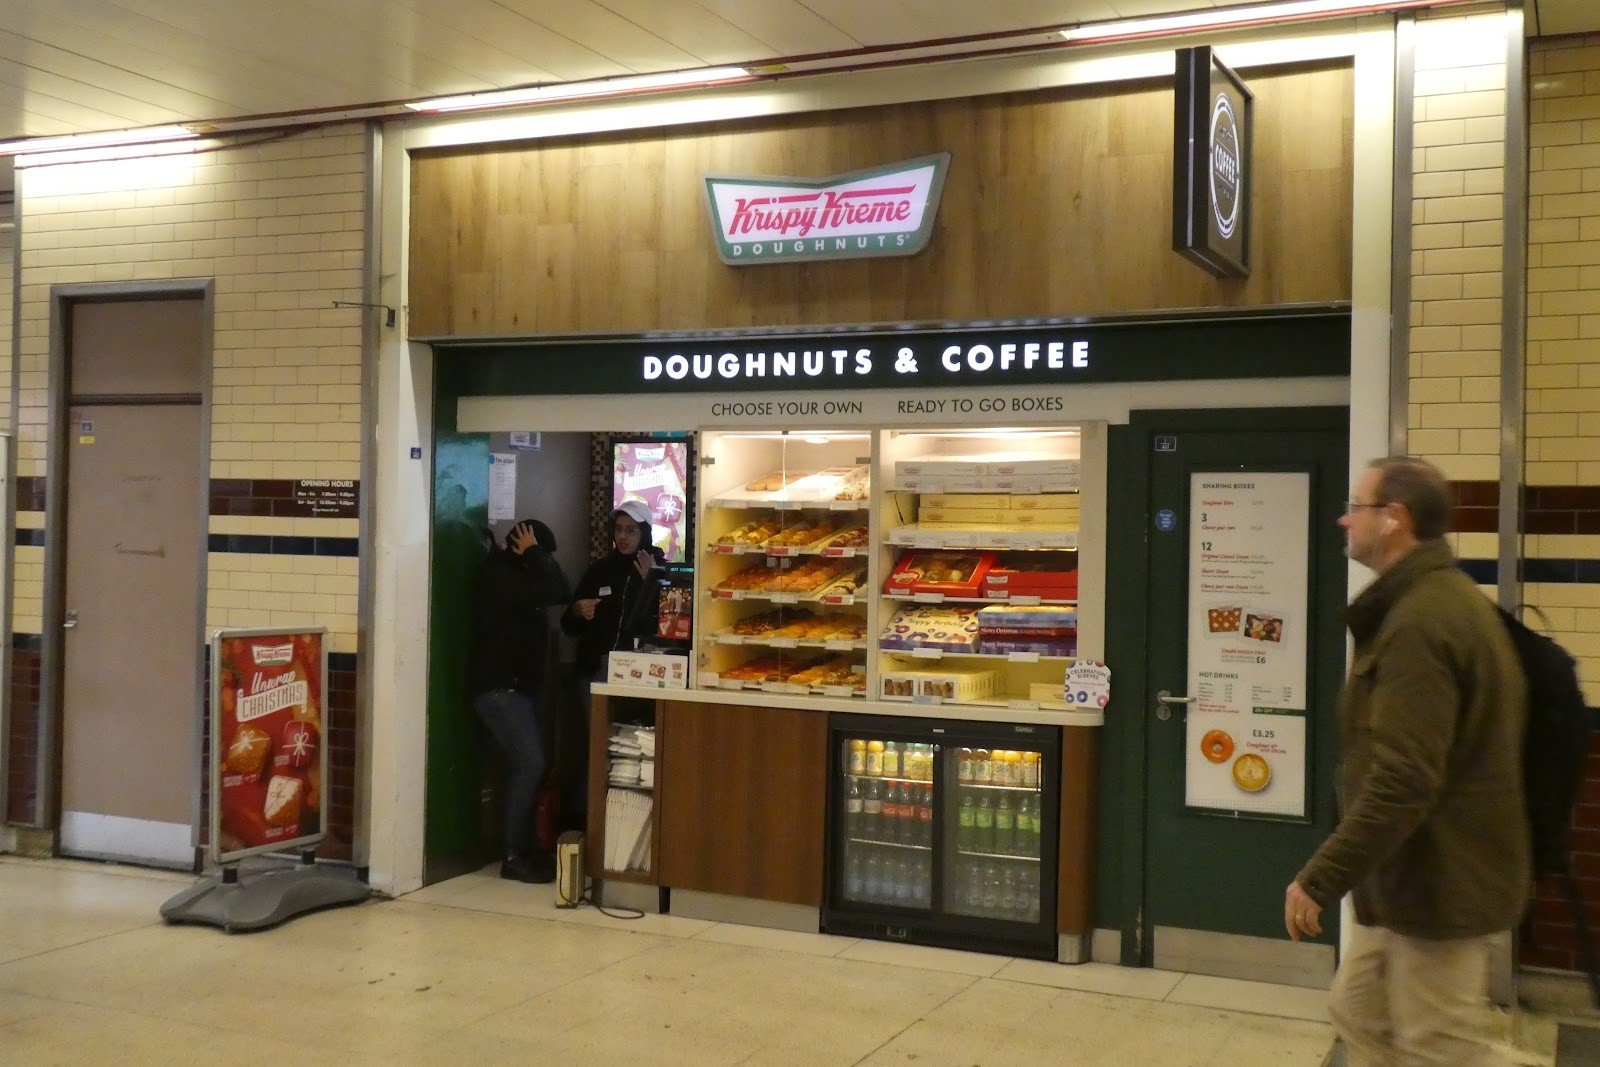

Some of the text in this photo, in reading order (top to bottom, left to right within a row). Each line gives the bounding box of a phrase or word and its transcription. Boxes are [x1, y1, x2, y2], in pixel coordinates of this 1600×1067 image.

[1215, 144, 1235, 184] COFFEE
[729, 183, 917, 236] Krispy Kreme
[733, 235, 905, 256] DOUGHNUTS
[643, 341, 1090, 380] DOUGHNUTS & COFFEE
[711, 401, 863, 416] CHOOSE YOUR OWN
[897, 397, 1064, 414] READY TO GO BOXES
[331, 480, 354, 488] HOURS
[1202, 513, 1208, 522] 3
[1202, 542, 1212, 551] 12
[1071, 669, 1106, 677] CELEBRATION
[251, 671, 296, 694] Unwrap
[242, 683, 303, 719] CHRISTMAS
[1253, 729, 1275, 739] £3.25
